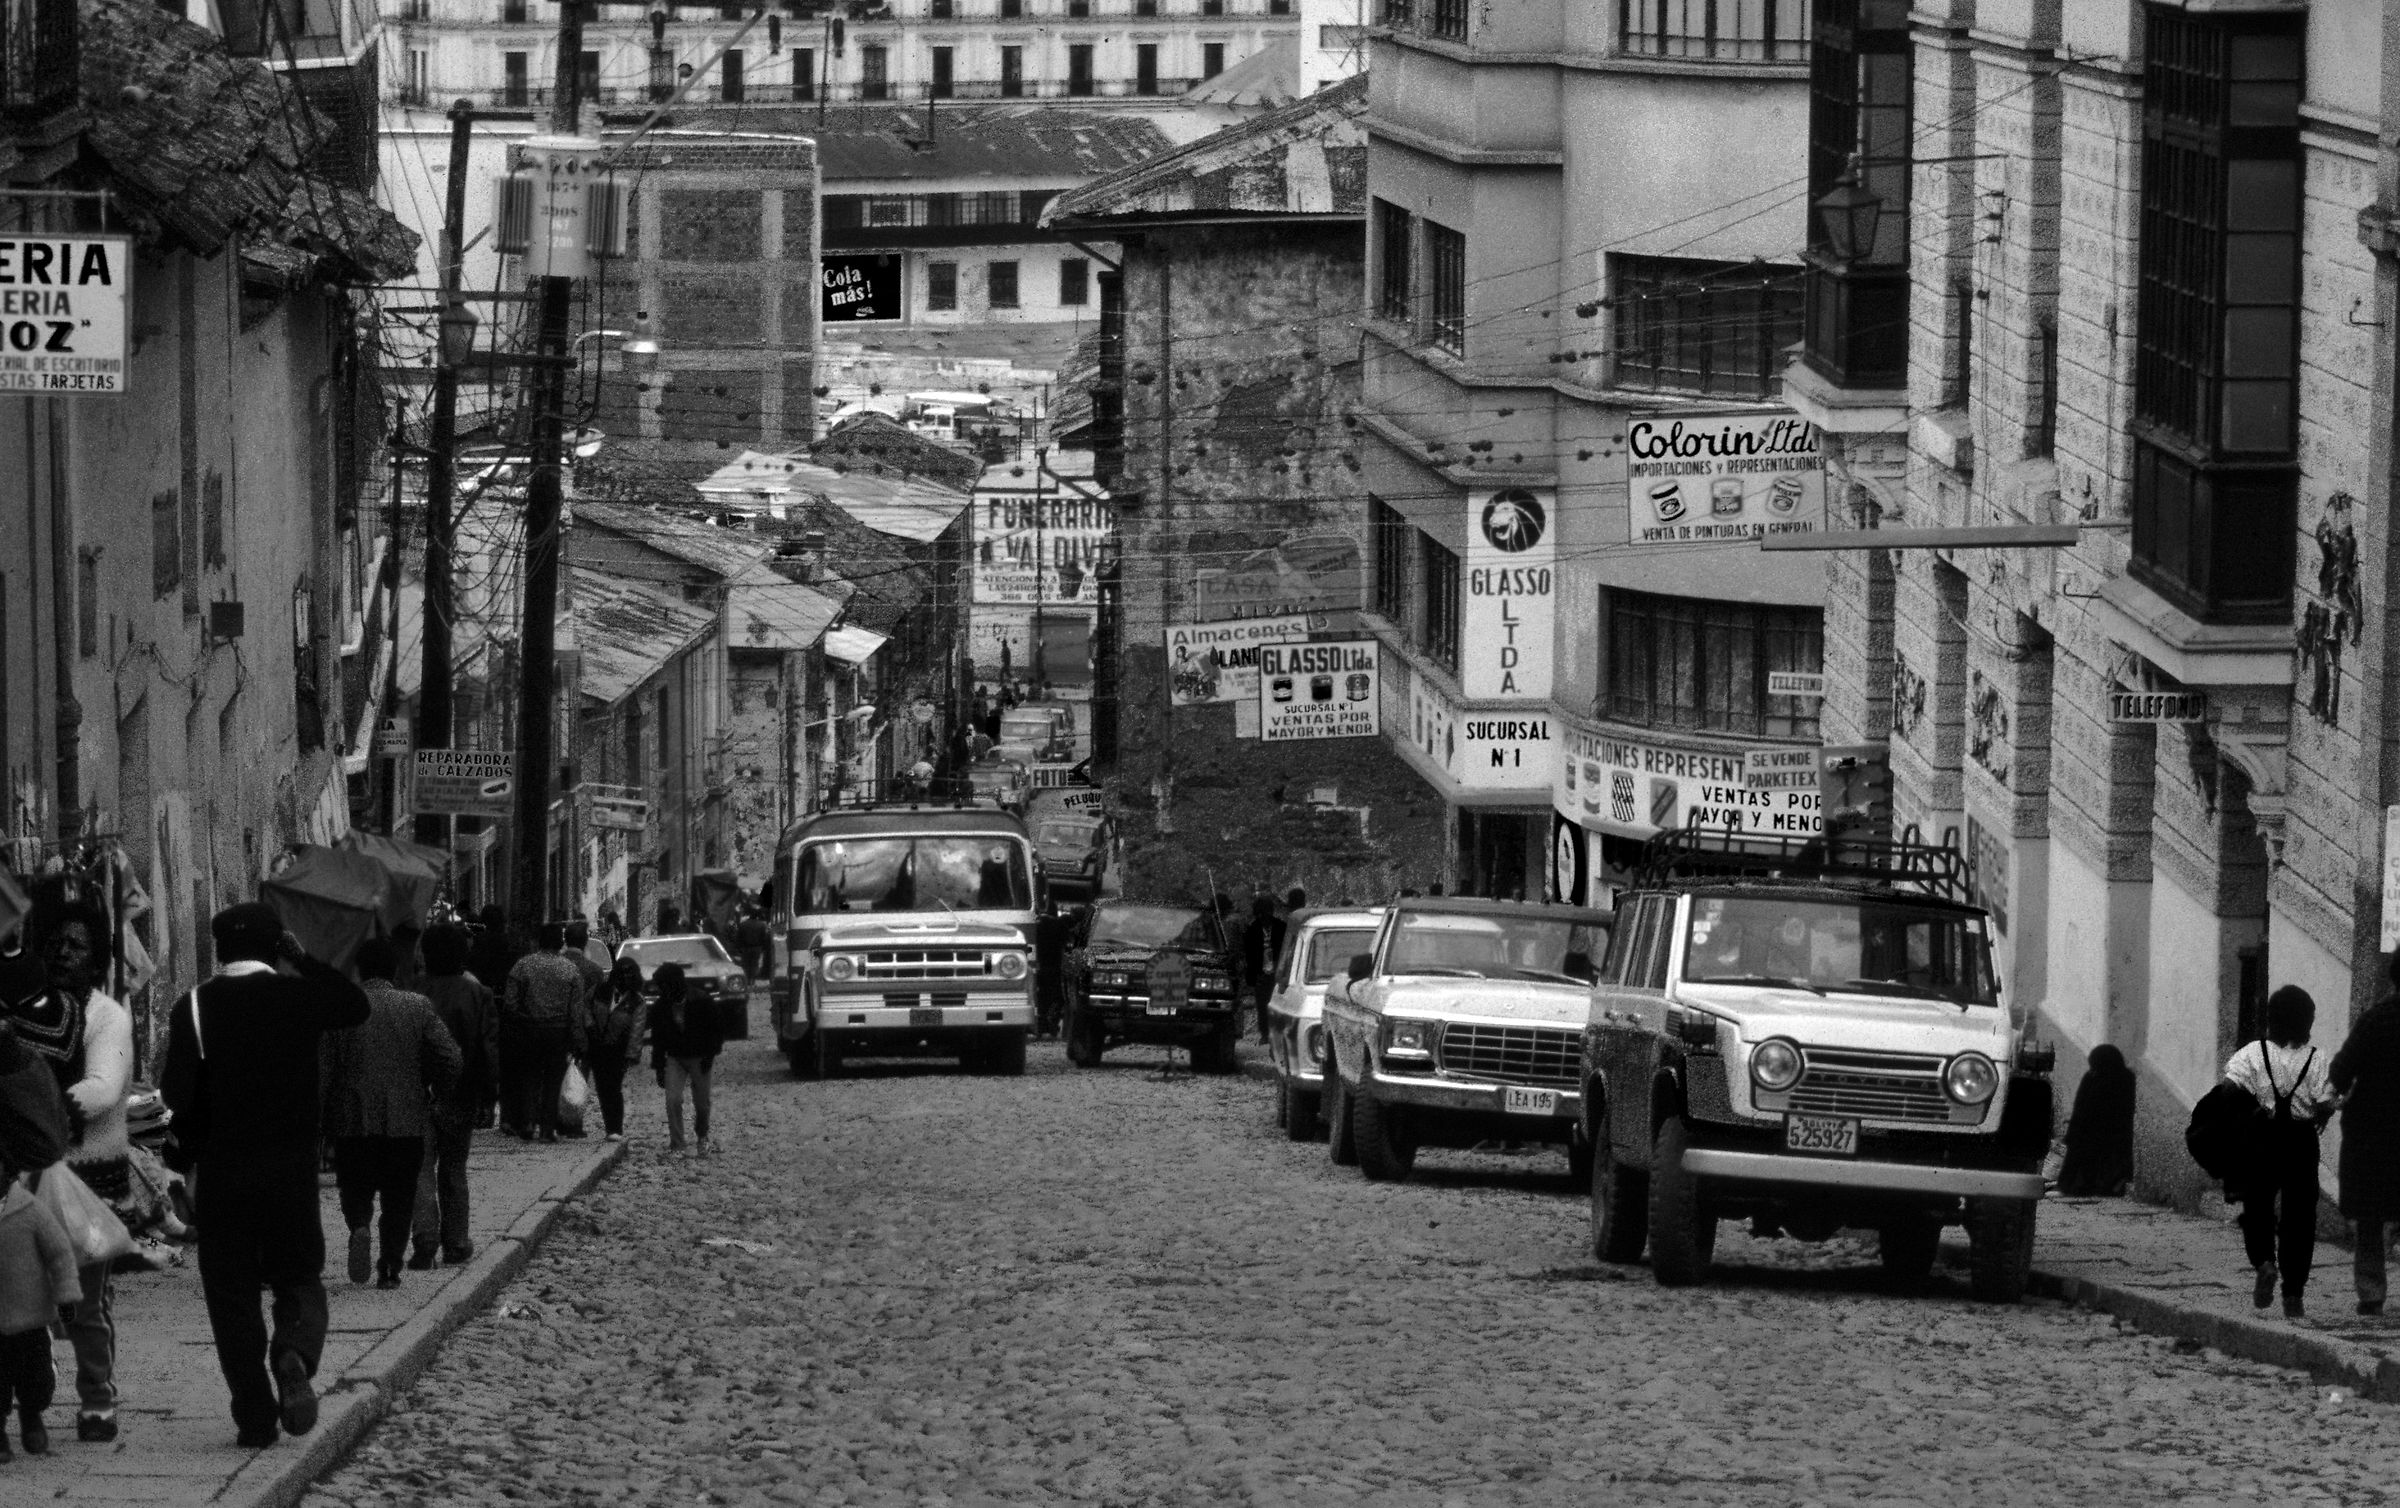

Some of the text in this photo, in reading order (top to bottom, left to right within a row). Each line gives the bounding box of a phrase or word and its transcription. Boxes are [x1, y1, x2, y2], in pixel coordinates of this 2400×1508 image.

[823, 265, 862, 288] Cola
[831, 280, 873, 306] más!
[0, 290, 71, 317] ERIA
[34, 356, 48, 372] DE
[52, 357, 121, 373] ESCRITORIO
[42, 374, 114, 390] TARJETAS
[1630, 421, 1764, 459] Colorin
[1630, 460, 1711, 478] IMPORTACIONES
[1727, 456, 1824, 474] REPRESENTACIONES
[1643, 526, 1676, 541] VENTA
[1679, 526, 1691, 539] DE
[1695, 524, 1748, 538] PINTURAS
[1753, 523, 1765, 535] EN
[1471, 568, 1550, 596] GLASSO
[1172, 621, 1303, 646] Almacenes
[1262, 647, 1341, 676] GLASSO
[1284, 703, 1337, 714] SUCURSAL
[2111, 695, 2202, 720] TELEFONO
[1272, 713, 1334, 726] VENTAS
[1268, 727, 1315, 739] MAYOR
[1326, 723, 1373, 736] MENOR
[1466, 721, 1550, 740] SUCURSAL
[418, 752, 511, 766] REPARADORA
[1752, 752, 1811, 767] SE VENDE
[437, 765, 513, 778] CALZADOS
[1034, 769, 1067, 786] FOTO
[1747, 770, 1817, 788] PARKETEX
[1702, 786, 1771, 807] VENTAS
[1752, 811, 1761, 828] Y
[1789, 1126, 1853, 1150] 525927
